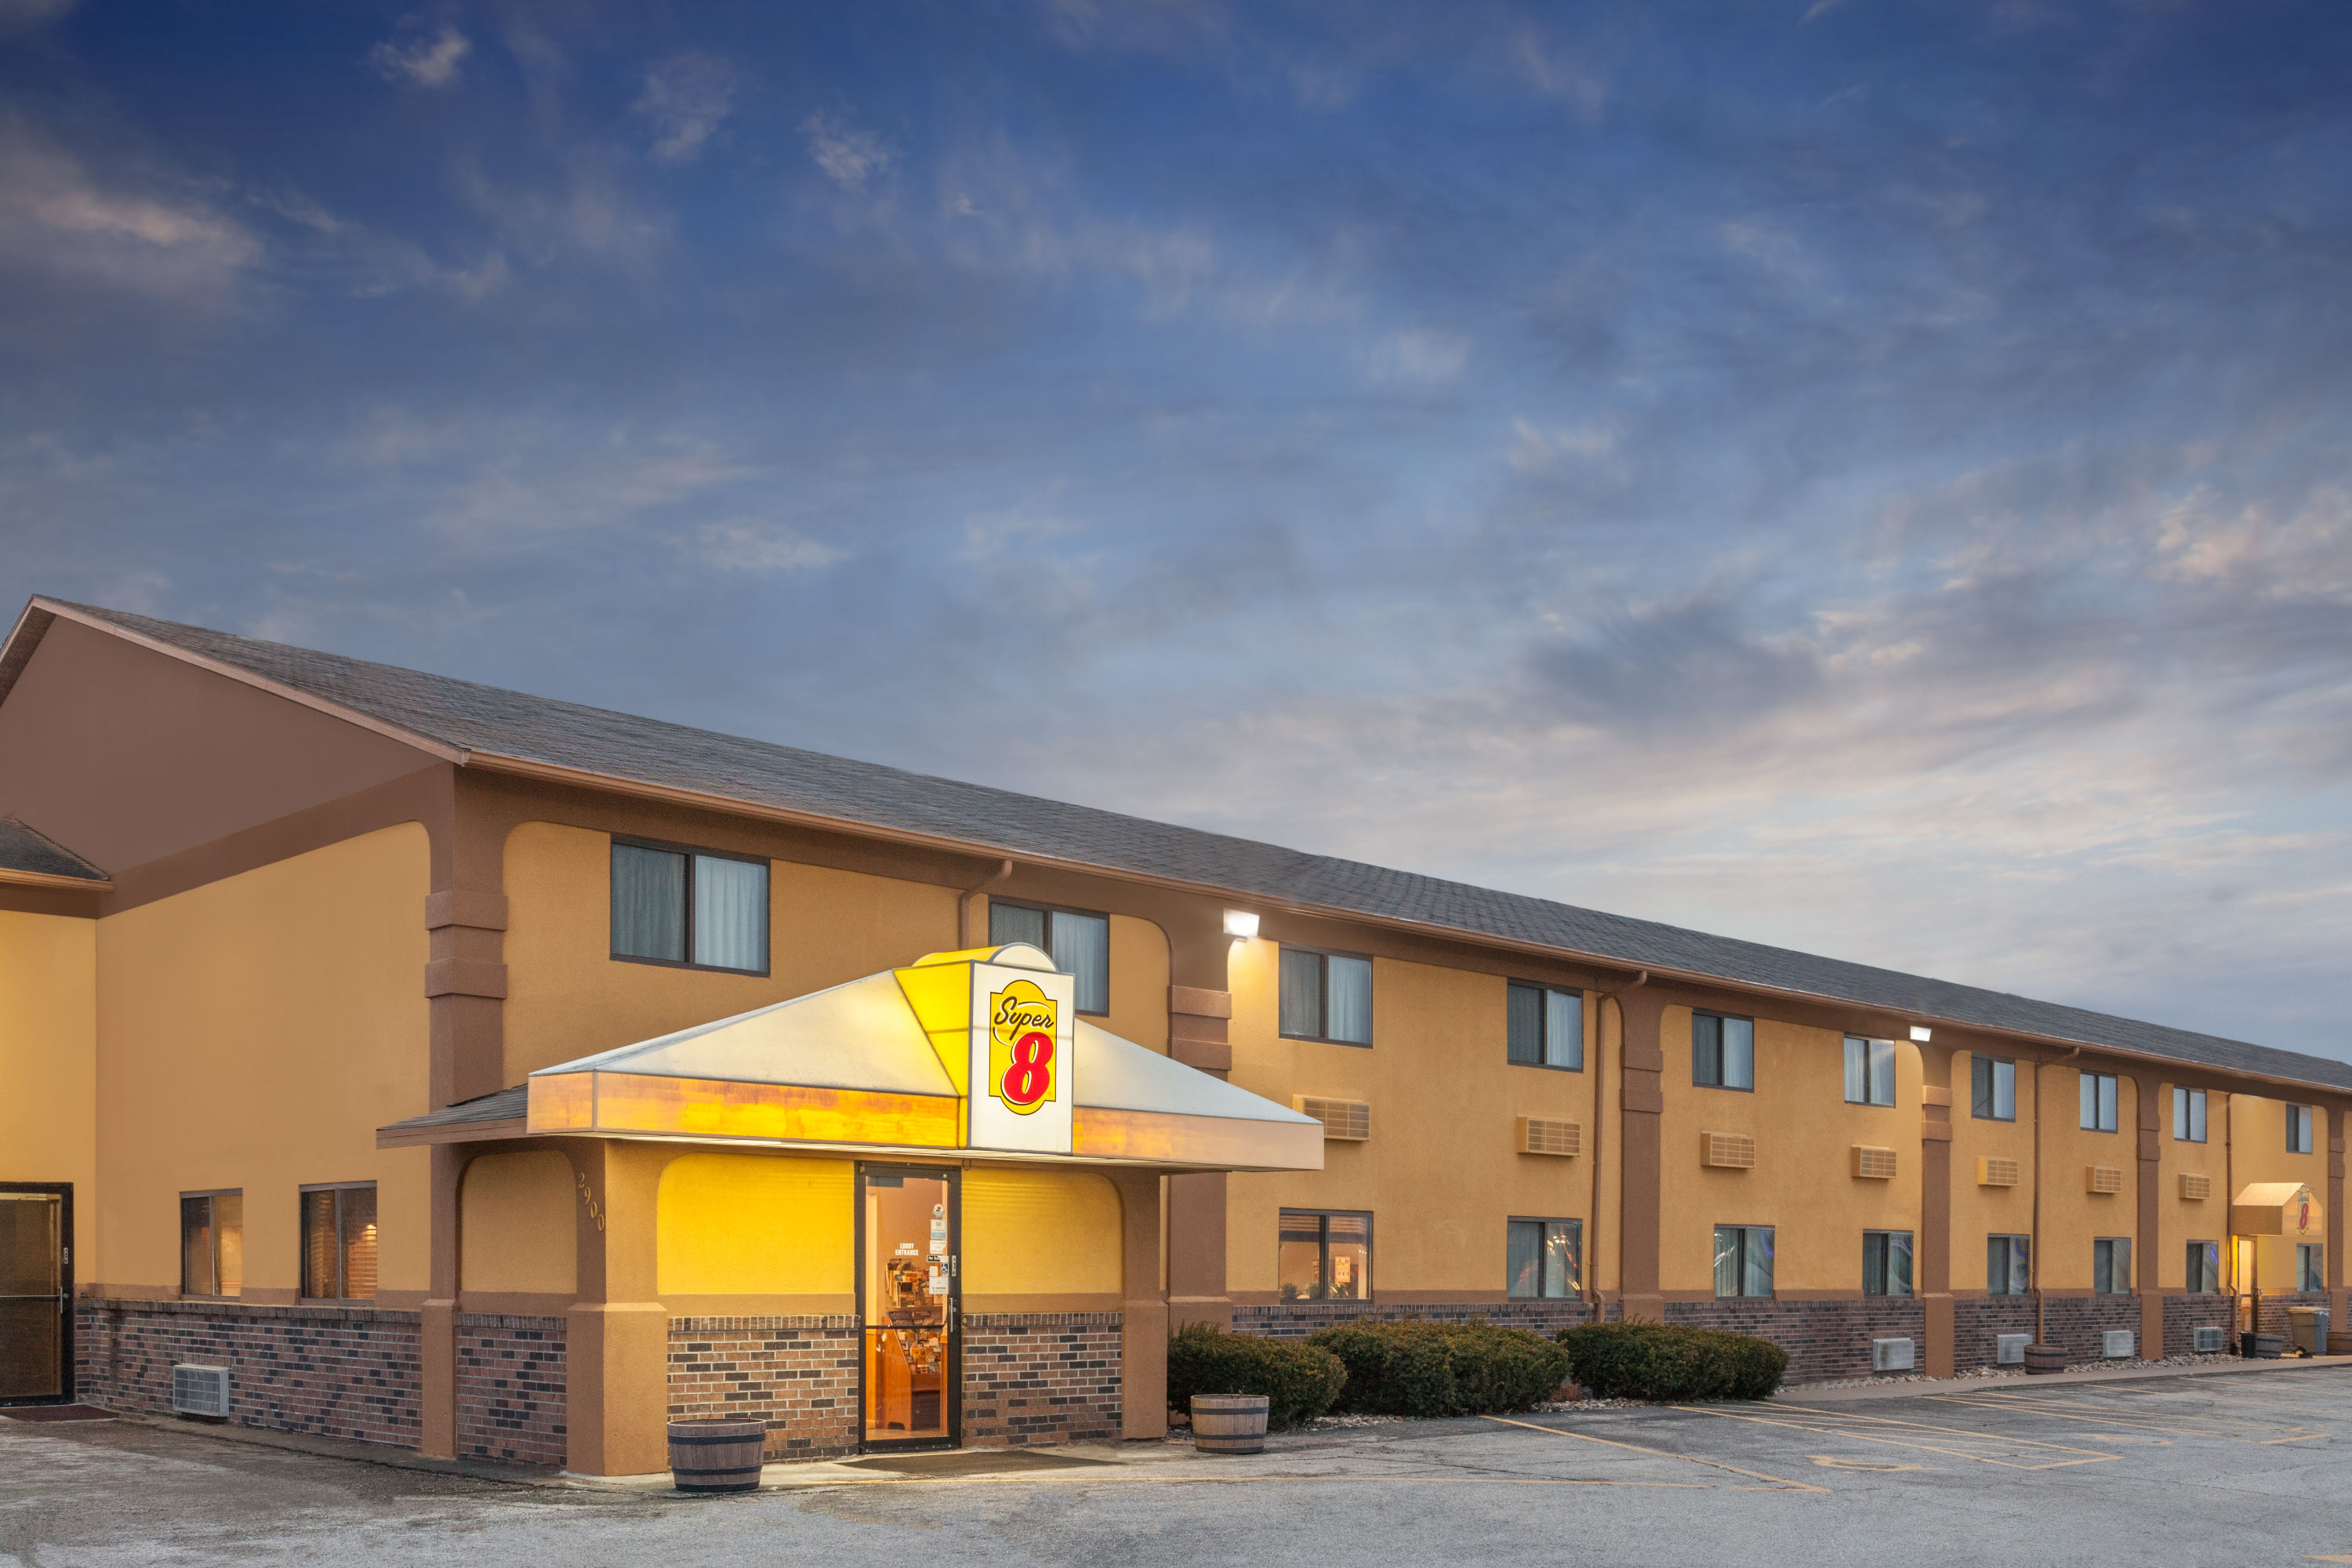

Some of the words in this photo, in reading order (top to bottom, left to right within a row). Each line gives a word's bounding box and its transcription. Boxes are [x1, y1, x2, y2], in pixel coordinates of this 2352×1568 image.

[994, 996, 1054, 1040] Super
[1001, 1031, 1054, 1105] 8
[579, 1172, 604, 1232] 2900
[2299, 1203, 2309, 1229] 8
